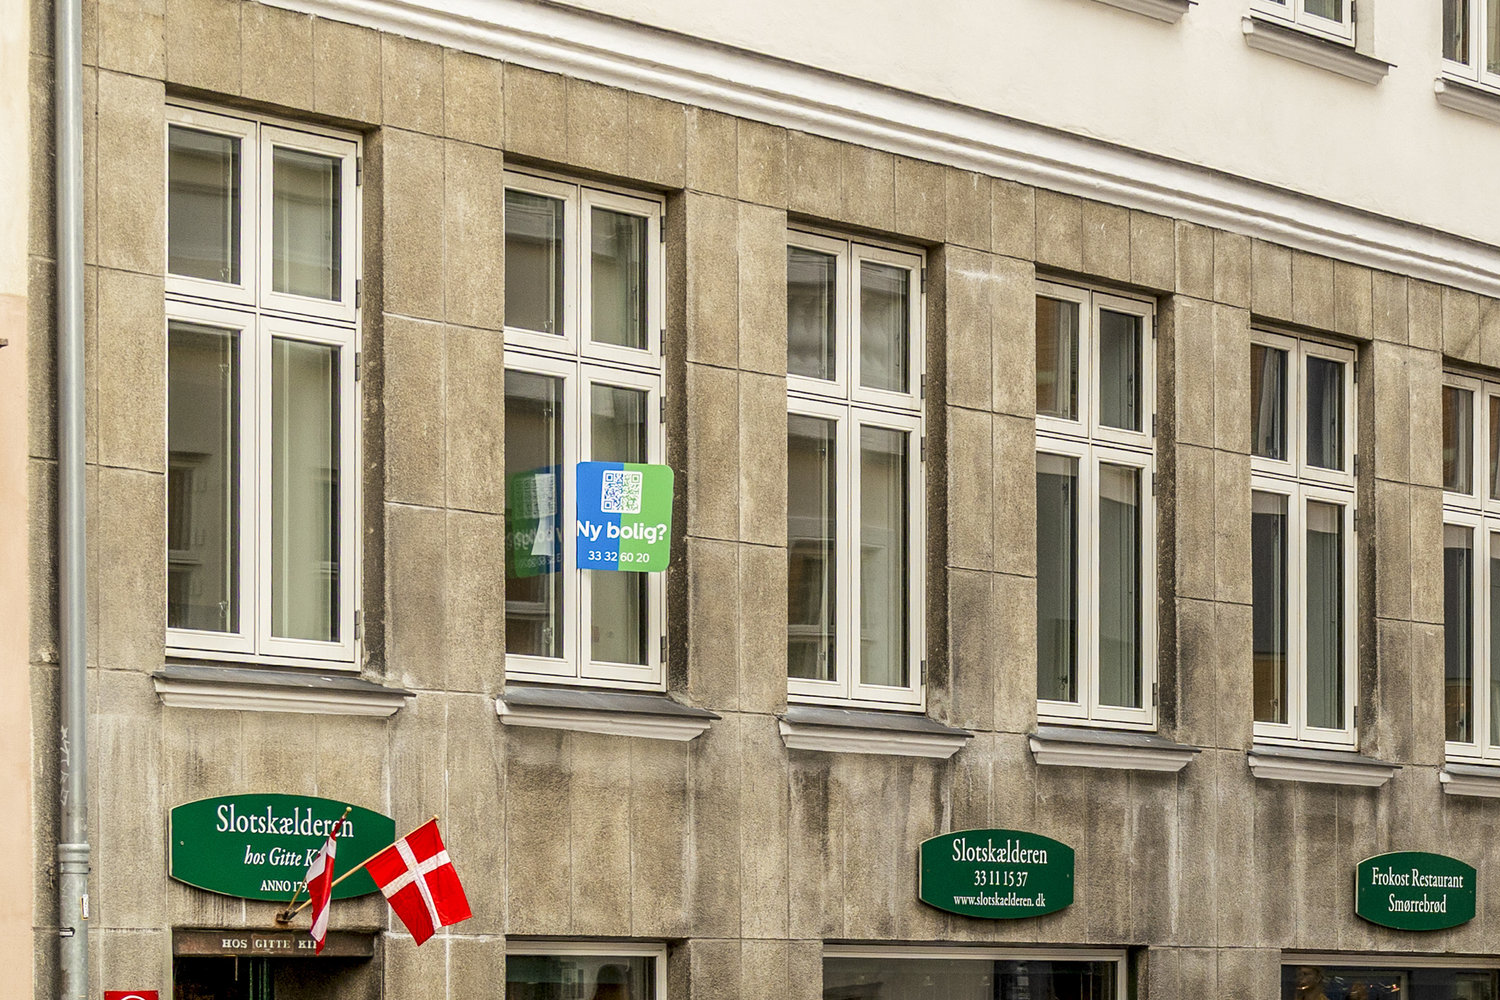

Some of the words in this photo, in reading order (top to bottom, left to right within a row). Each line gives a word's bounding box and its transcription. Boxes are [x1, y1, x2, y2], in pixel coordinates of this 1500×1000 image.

[577, 520, 603, 541] Ny
[607, 522, 667, 544] bolig?
[588, 550, 602, 561] 33
[604, 551, 618, 562] 32
[620, 552, 634, 562] 60
[636, 553, 650, 563] 20
[216, 803, 354, 837] Slotskælderen
[244, 844, 265, 865] hos
[269, 847, 301, 867] Gitte
[952, 837, 1048, 864] Slotskælderen
[260, 880, 291, 892] ANNO
[974, 870, 987, 886] 33
[989, 870, 1000, 885] 11
[1003, 871, 1015, 886] 15
[1016, 872, 1028, 887] 37
[1372, 866, 1410, 886] Frokost
[1411, 868, 1463, 888] Restaurant
[1388, 893, 1447, 913] Smørrebrød
[222, 939, 248, 949] HOS
[255, 939, 290, 949] GITTE
